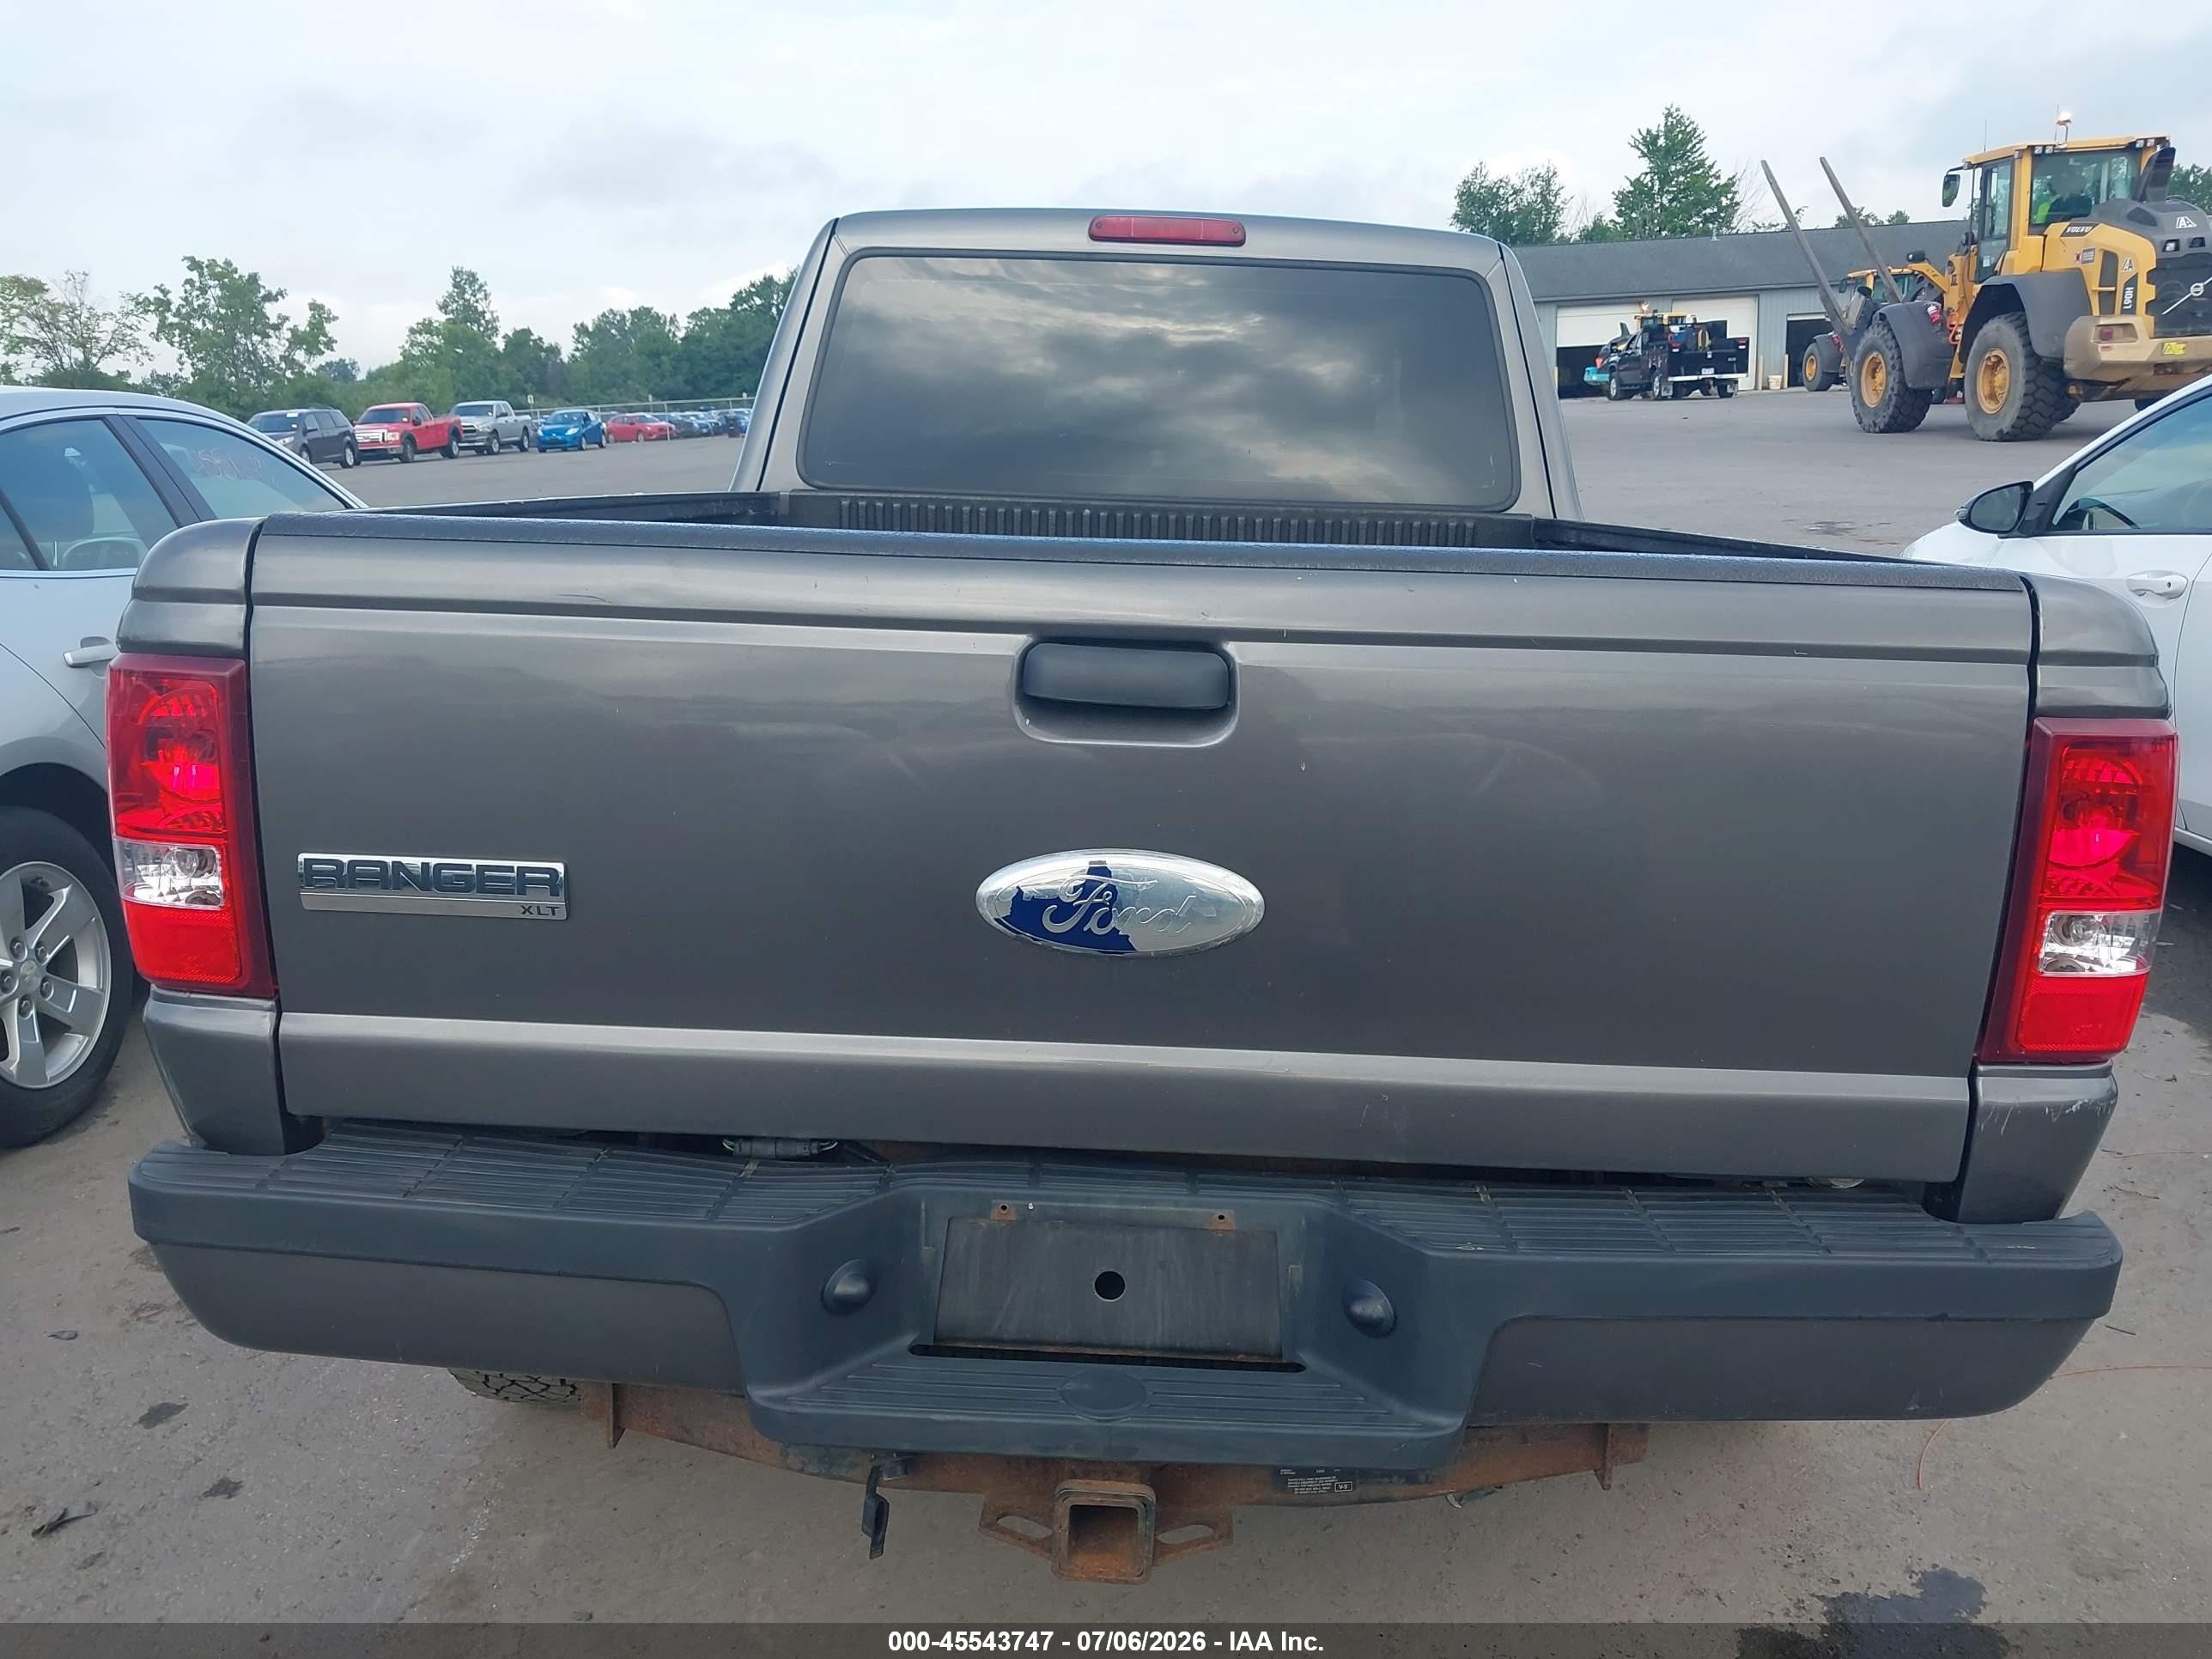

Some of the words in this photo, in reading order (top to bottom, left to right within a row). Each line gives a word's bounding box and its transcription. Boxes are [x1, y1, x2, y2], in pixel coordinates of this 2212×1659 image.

[2123, 287, 2135, 309] L90H
[301, 855, 562, 897] RANGER
[519, 903, 561, 917] XLT
[1041, 873, 1198, 936] Ford
